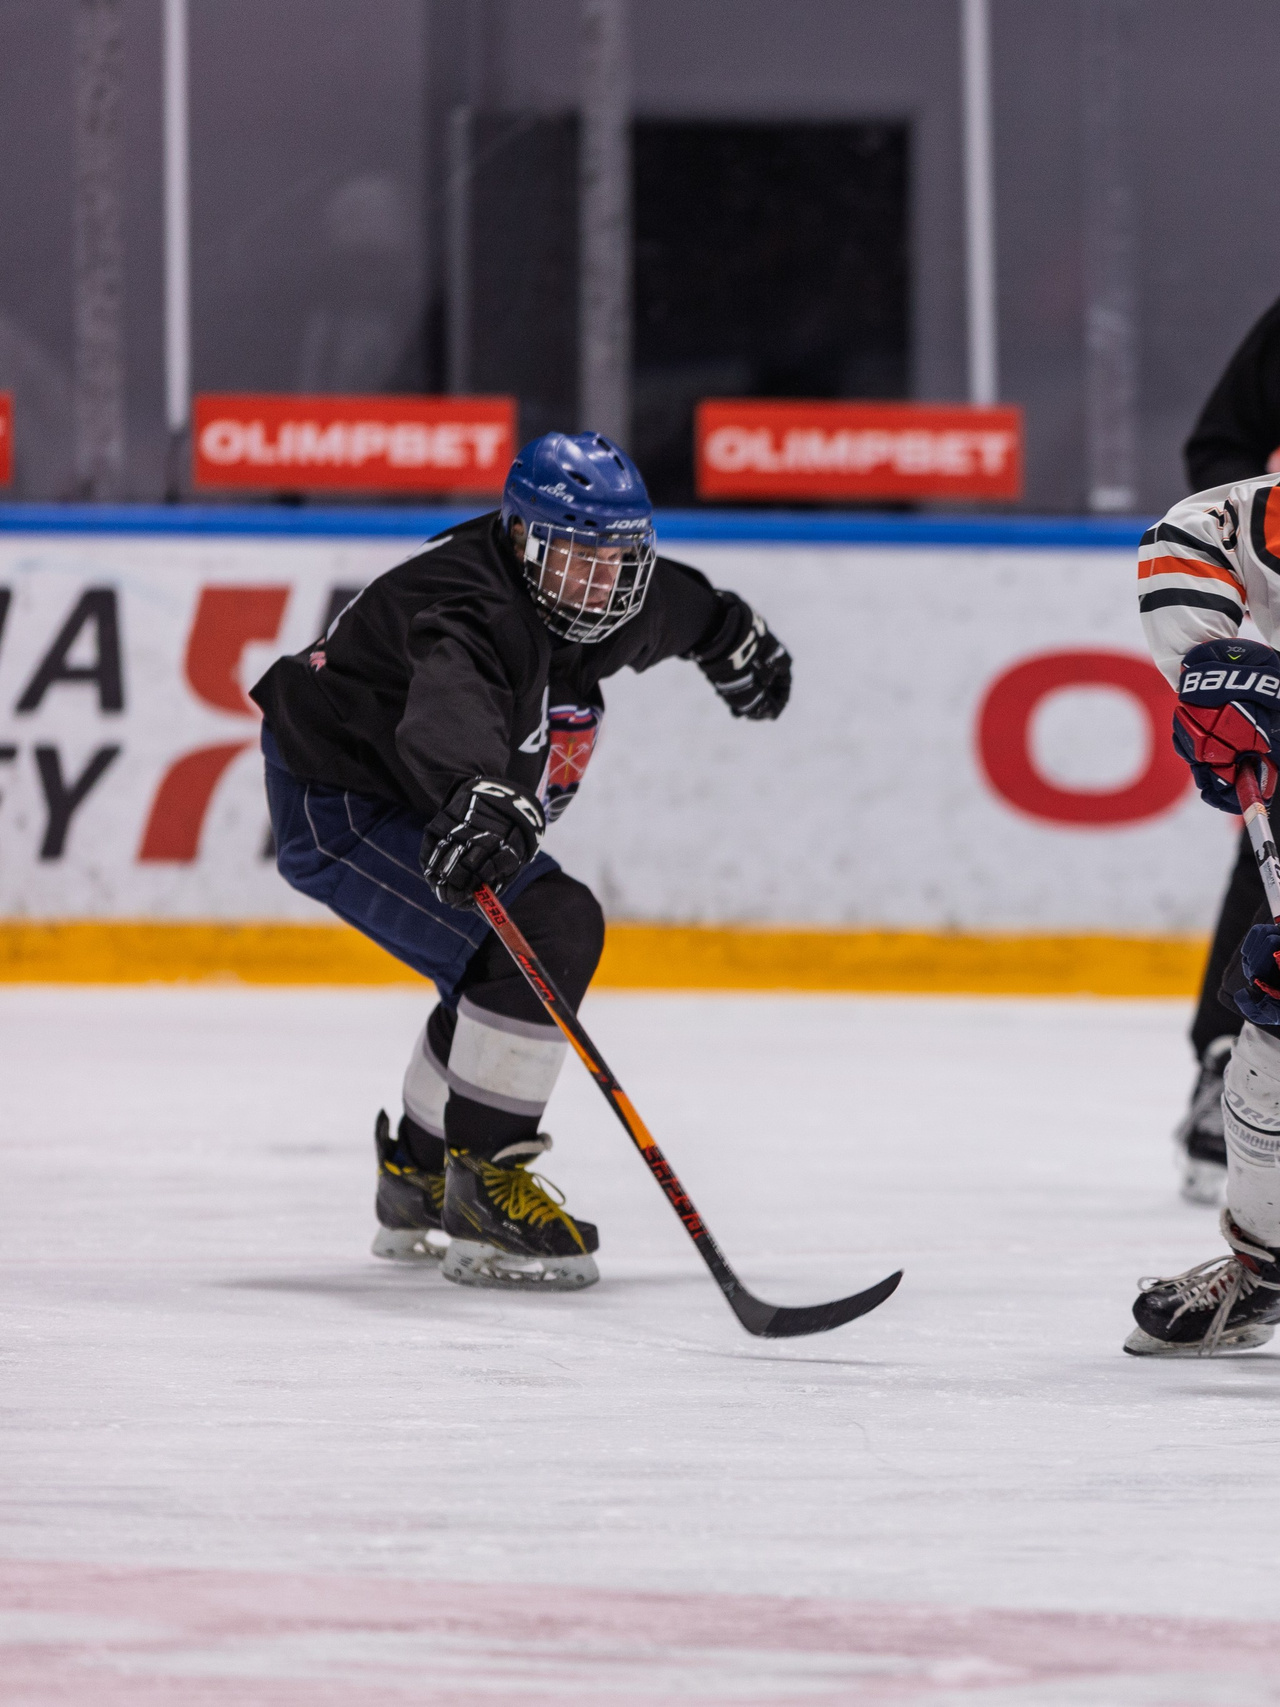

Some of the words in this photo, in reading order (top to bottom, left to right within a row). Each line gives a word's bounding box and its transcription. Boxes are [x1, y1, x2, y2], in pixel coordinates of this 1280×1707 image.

[201, 418, 507, 468] OLIMPBET
[706, 424, 1012, 475] OLIMPBET
[538, 484, 575, 503] JOFA
[605, 518, 649, 530] JOFA
